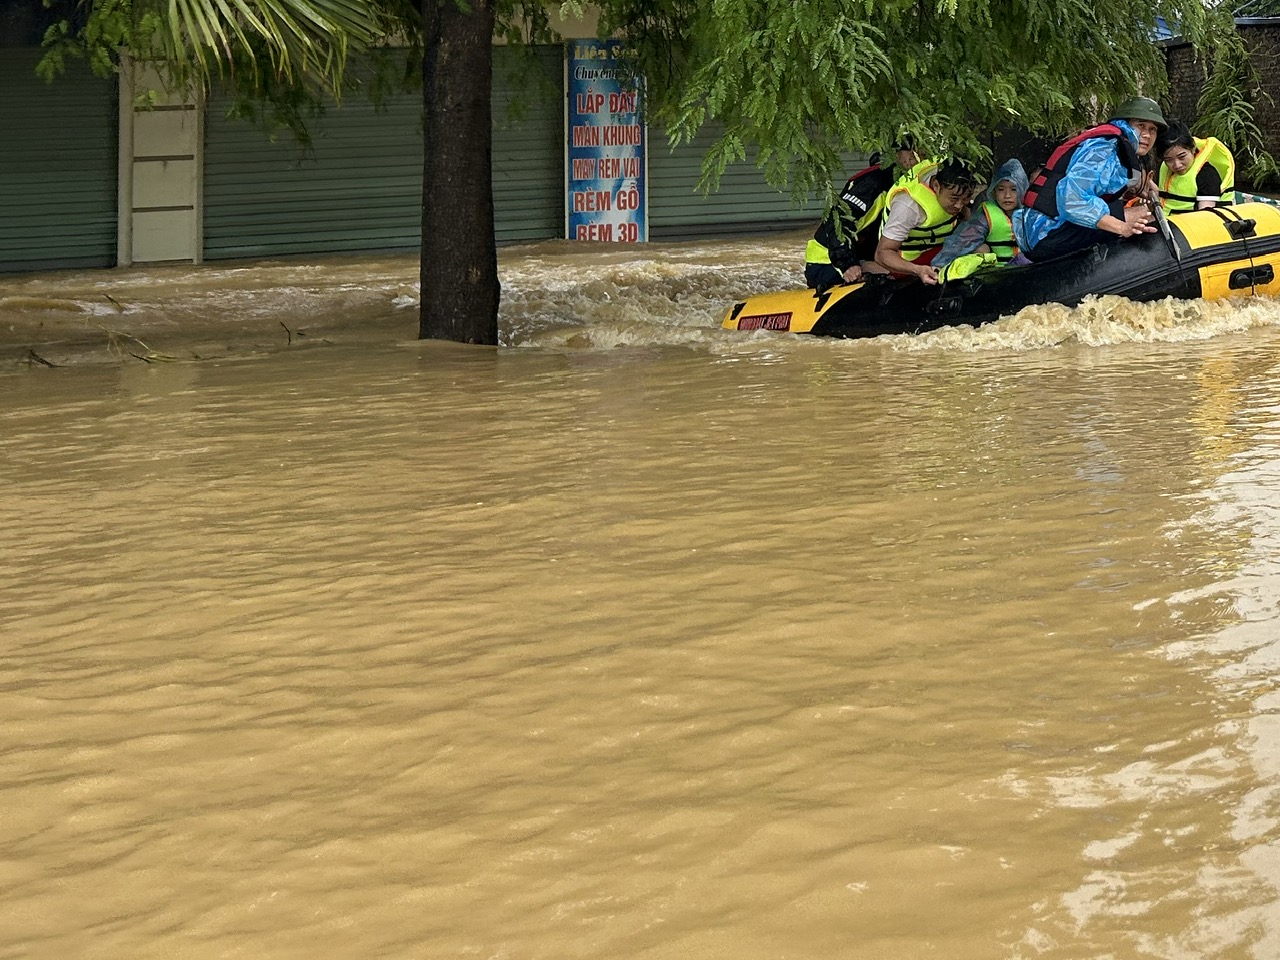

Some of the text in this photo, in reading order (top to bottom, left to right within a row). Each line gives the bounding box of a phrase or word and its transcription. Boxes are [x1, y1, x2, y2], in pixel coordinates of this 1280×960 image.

[577, 86, 605, 114] LẮP
[572, 121, 641, 147] MÀN KHUNG
[573, 158, 595, 180] MAY
[598, 154, 620, 179] RÈM
[574, 181, 639, 212] RÈM GỖ
[577, 221, 638, 242] RÈM 3D
